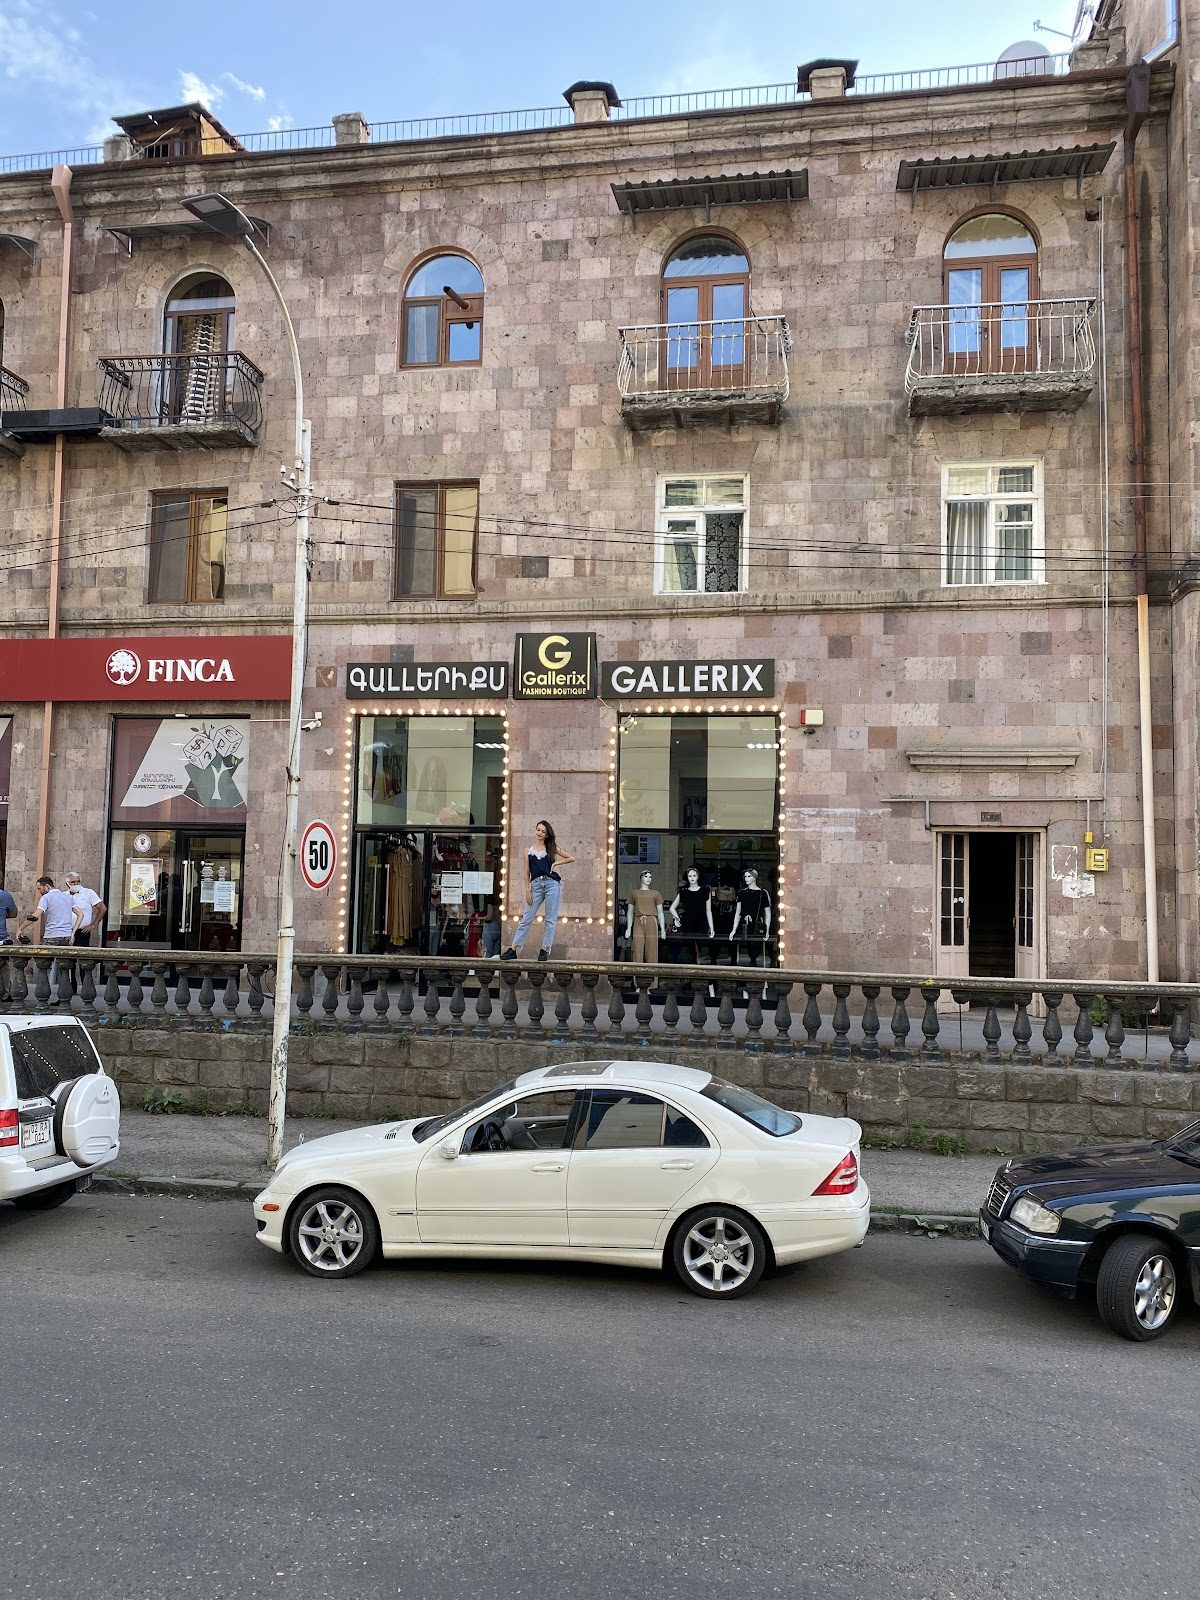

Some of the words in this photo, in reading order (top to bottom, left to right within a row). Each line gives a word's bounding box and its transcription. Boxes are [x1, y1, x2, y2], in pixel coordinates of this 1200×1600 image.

[538, 635, 572, 670] G
[146, 658, 236, 682] FINCA
[349, 666, 505, 693] ԳԱԼԼԵՐԻՔՍ
[522, 670, 587, 686] Gallerix
[611, 664, 764, 693] GALLERIX
[522, 687, 552, 695] FASHION
[553, 687, 587, 695] BOUTIQUE
[309, 840, 329, 871] 50
